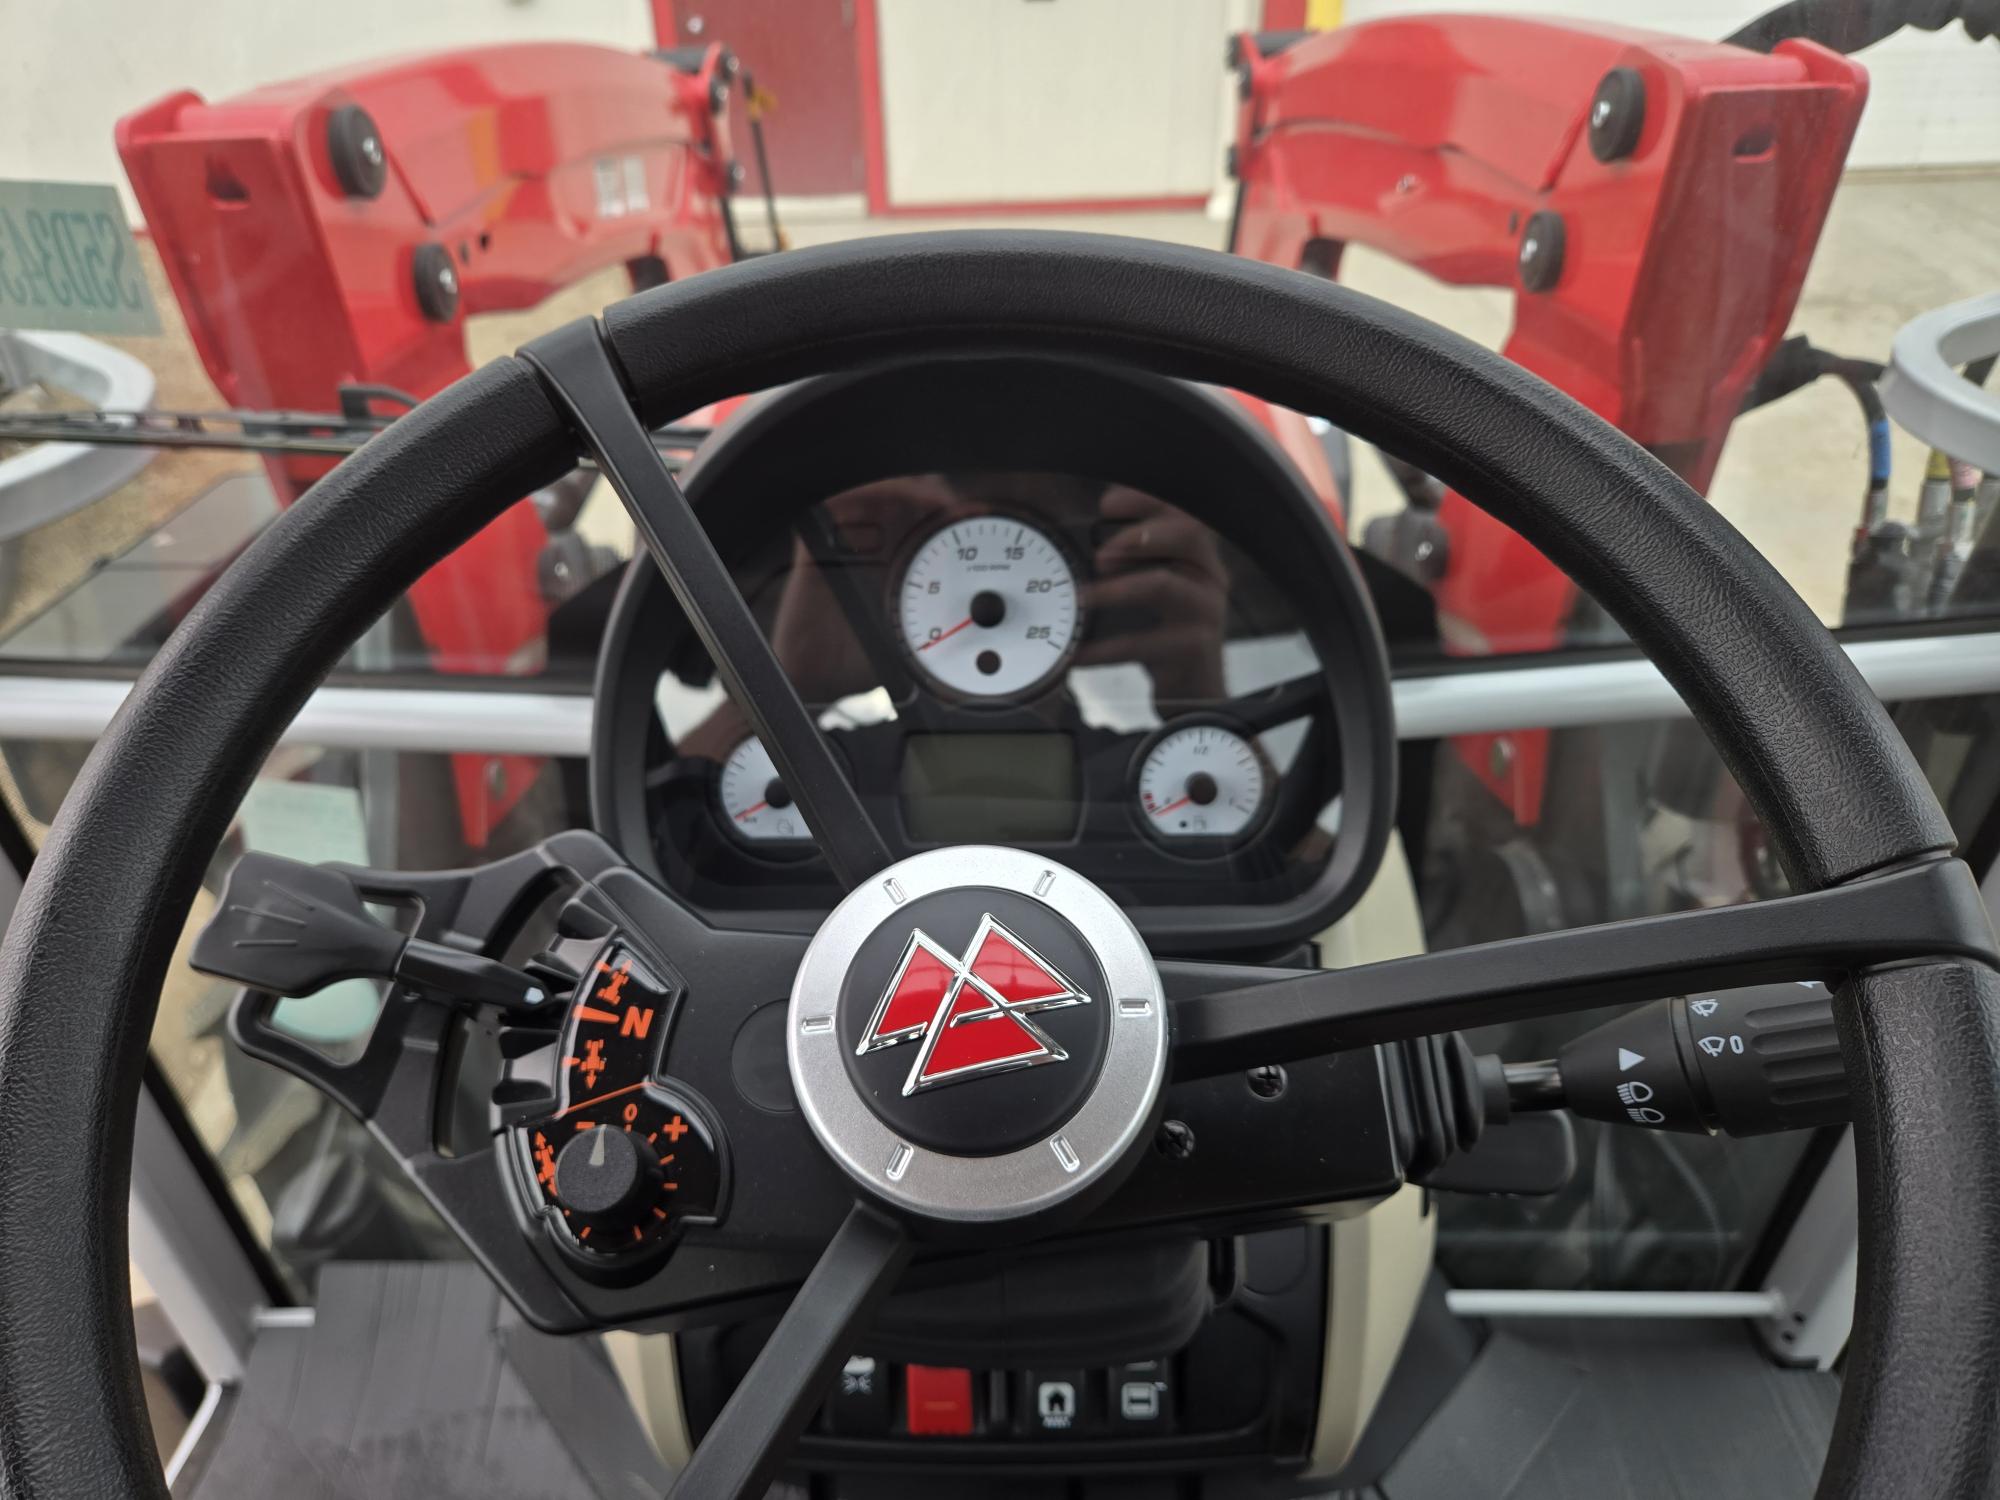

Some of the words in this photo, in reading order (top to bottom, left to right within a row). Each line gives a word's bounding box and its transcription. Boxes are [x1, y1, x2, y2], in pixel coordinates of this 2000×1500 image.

[957, 546, 978, 561] 10
[1005, 546, 1024, 561] 15
[928, 581, 940, 594] 5
[1025, 580, 1052, 593] 20
[929, 627, 942, 640] 0
[1025, 626, 1051, 639] 25
[620, 1005, 654, 1039] N
[624, 1103, 638, 1121] 0
